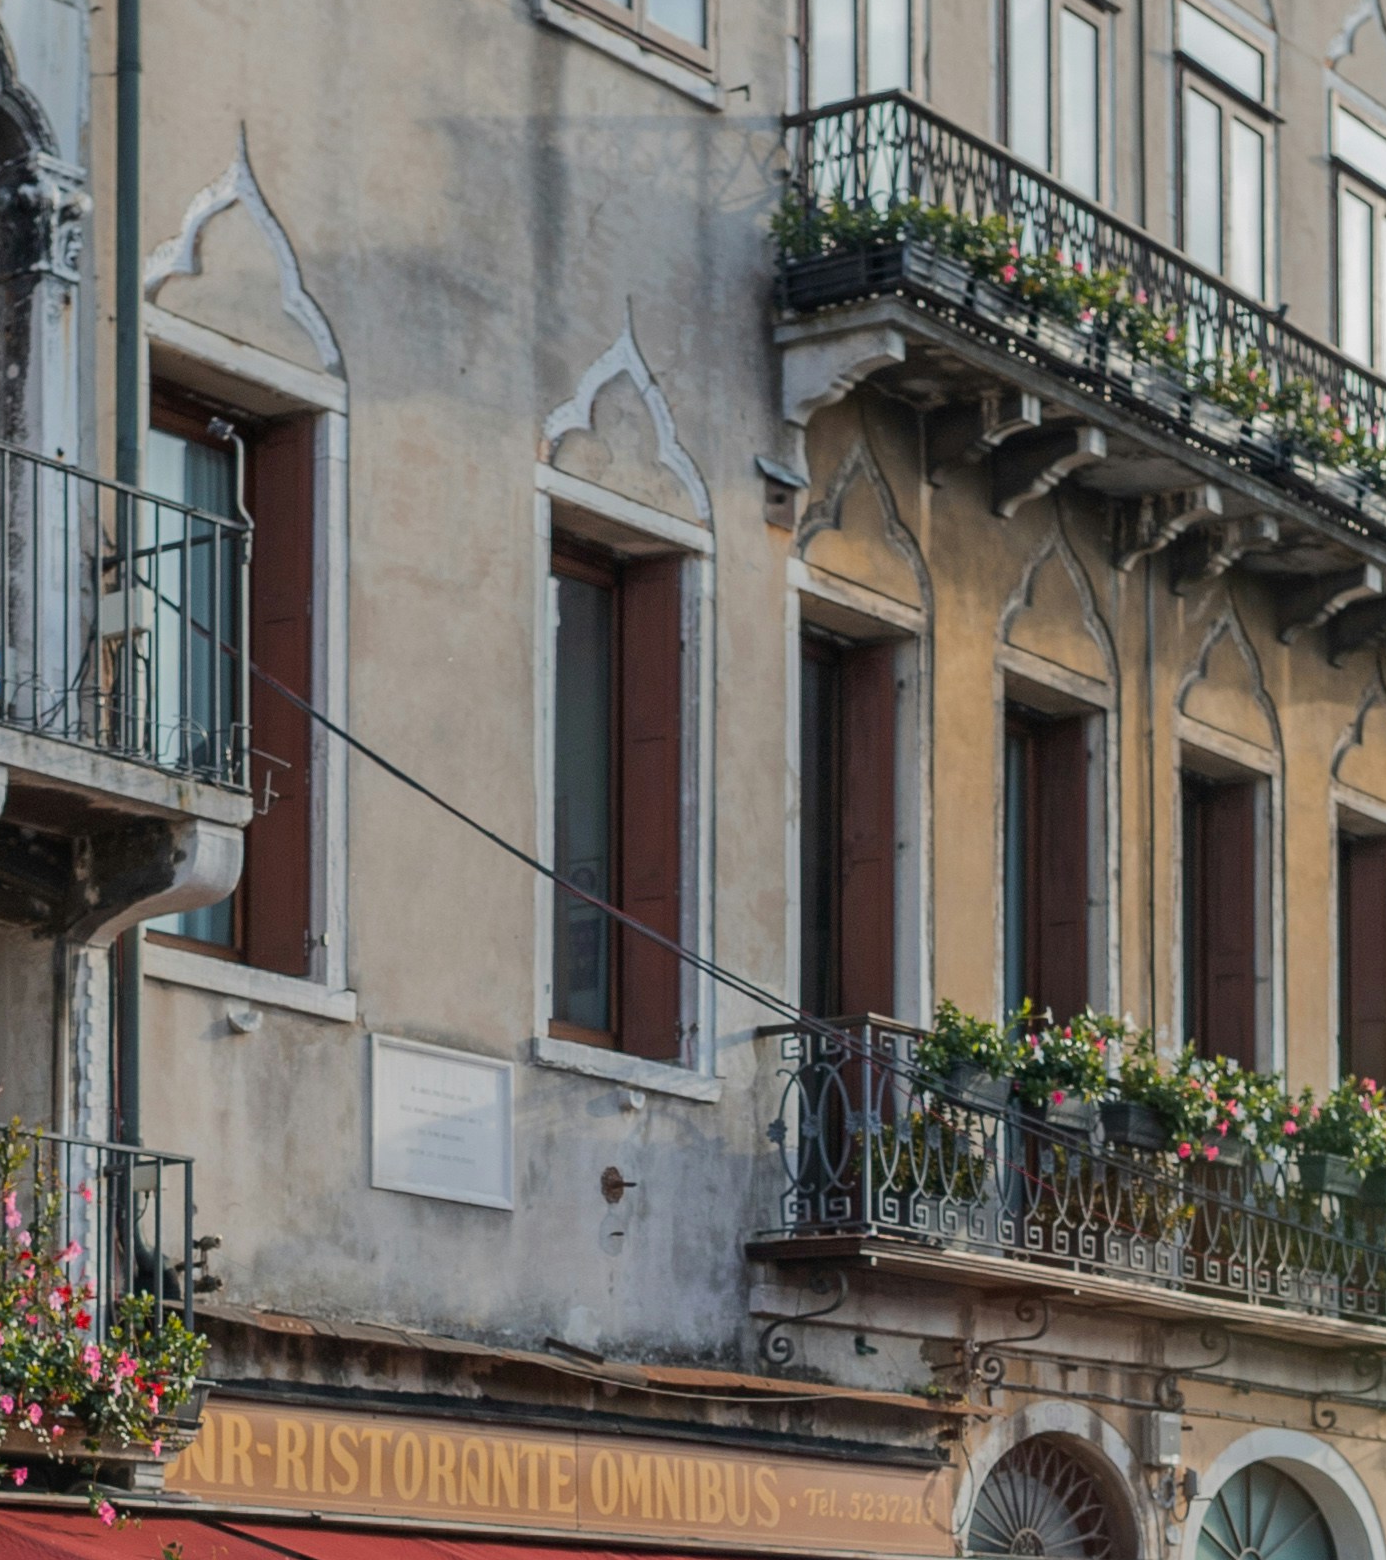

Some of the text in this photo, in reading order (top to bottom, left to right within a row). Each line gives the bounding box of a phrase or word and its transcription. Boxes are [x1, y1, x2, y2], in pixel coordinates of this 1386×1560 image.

[164, 1410, 578, 1516] AR-RISTORANTE
[591, 1449, 782, 1529] OMNIBUS
[804, 1488, 844, 1518] Tel.
